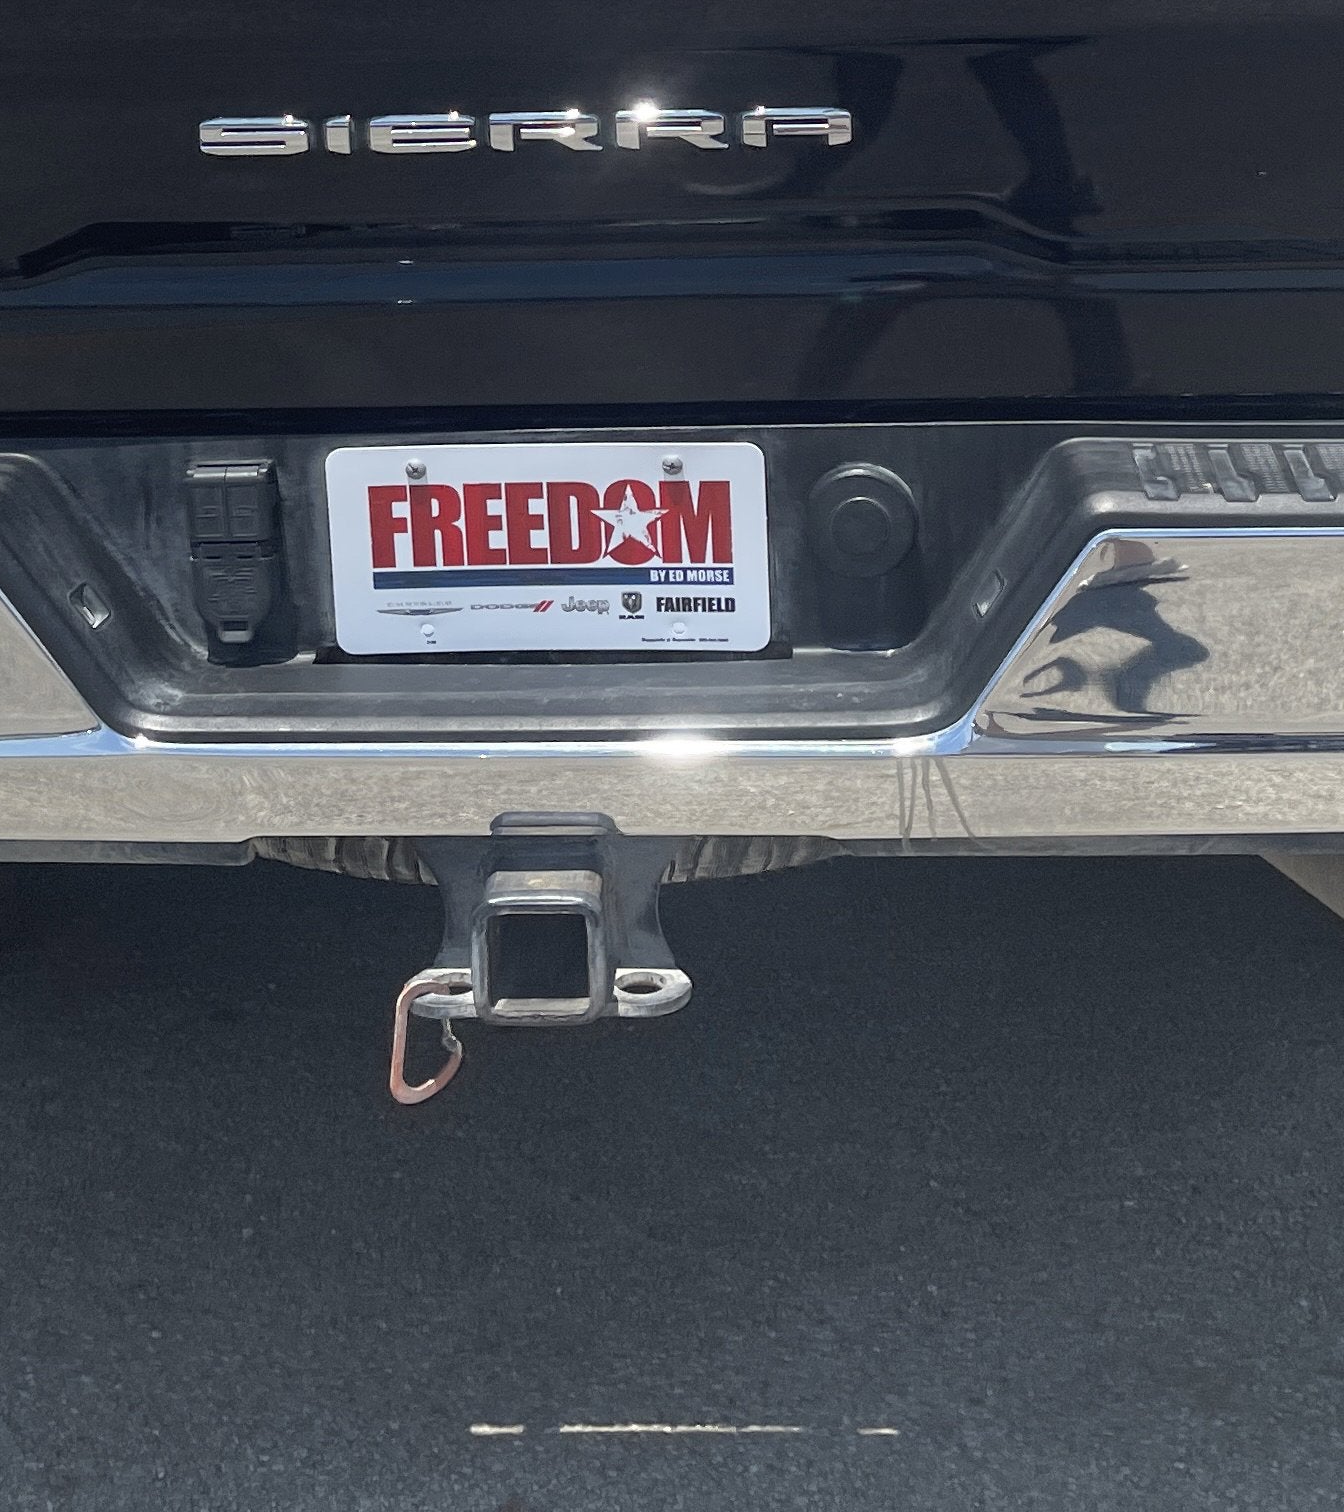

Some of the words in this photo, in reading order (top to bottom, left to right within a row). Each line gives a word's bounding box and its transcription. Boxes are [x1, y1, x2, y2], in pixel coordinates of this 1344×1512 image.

[198, 106, 853, 157] SIERRA
[367, 478, 734, 569] FREEDOM
[649, 569, 669, 583] BY
[668, 569, 684, 583] ED
[686, 569, 730, 583] MORSE
[560, 595, 611, 615] Jeep
[655, 596, 736, 613] FAIRFIELD
